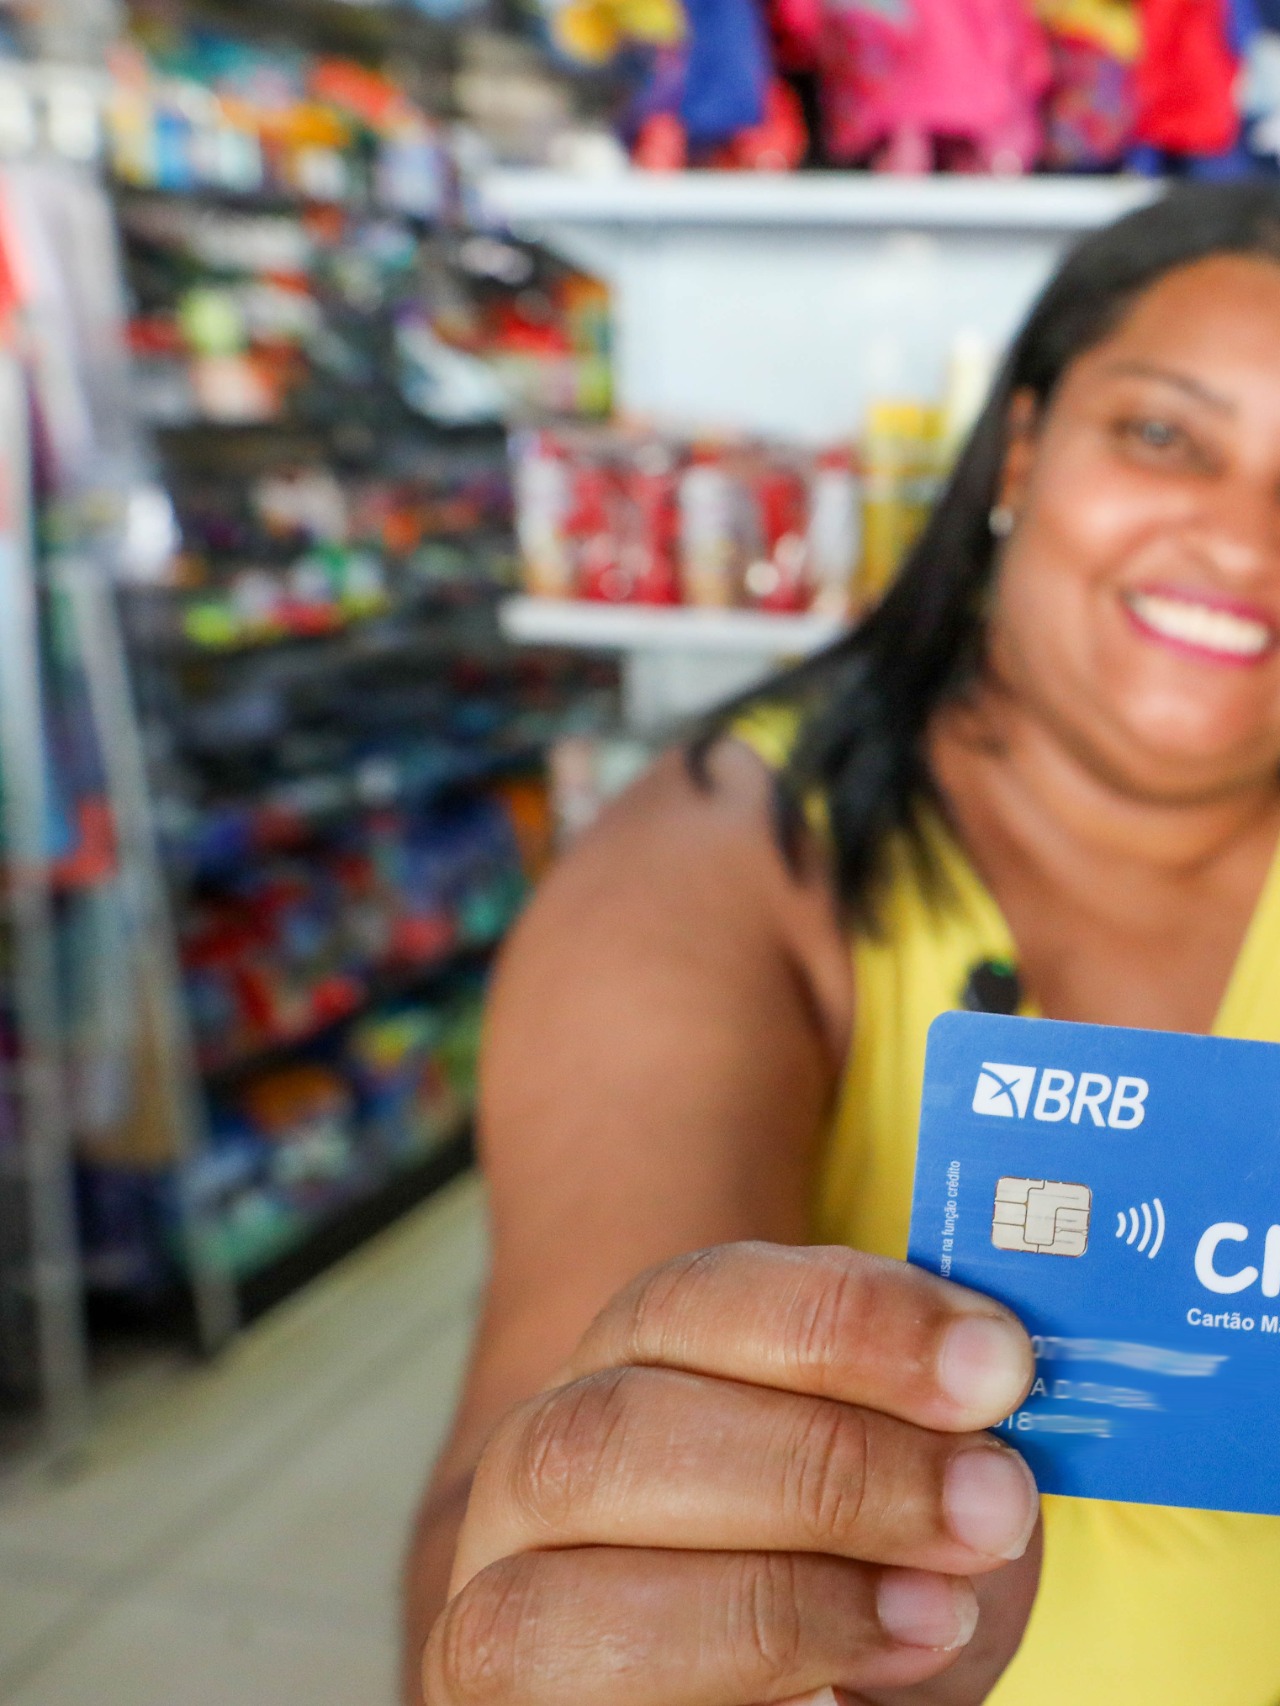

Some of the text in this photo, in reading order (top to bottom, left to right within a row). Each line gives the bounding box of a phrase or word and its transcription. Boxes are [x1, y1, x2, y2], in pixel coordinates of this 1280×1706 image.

[1033, 1068, 1150, 1130] BRB
[946, 1160, 961, 1197] crédito
[942, 1200, 959, 1235] função
[942, 1237, 954, 1251] na
[1186, 1307, 1255, 1331] Cartão
